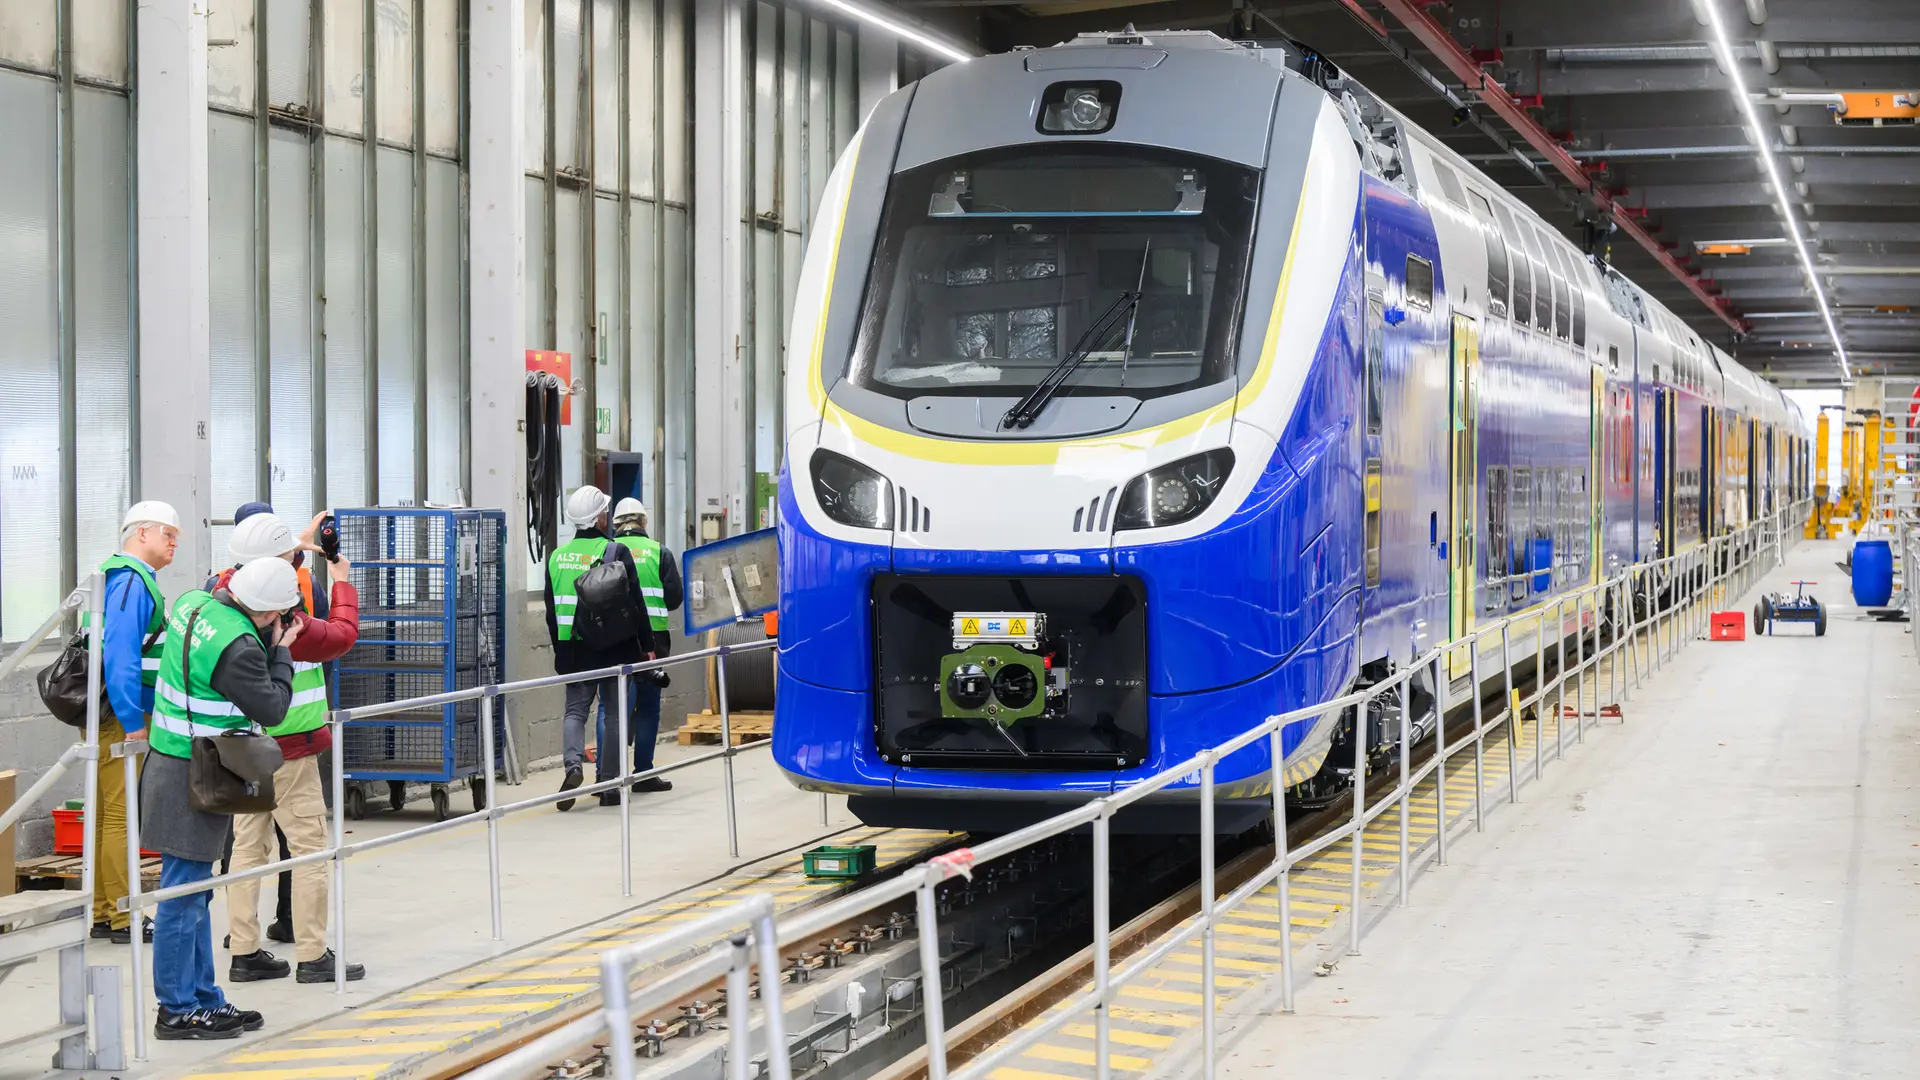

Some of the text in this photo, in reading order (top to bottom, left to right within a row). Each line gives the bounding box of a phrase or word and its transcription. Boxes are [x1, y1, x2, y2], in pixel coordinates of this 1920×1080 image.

[1875, 98, 1880, 107] 5
[558, 563, 591, 571] BESUCHE
[177, 603, 218, 641] ALOM
